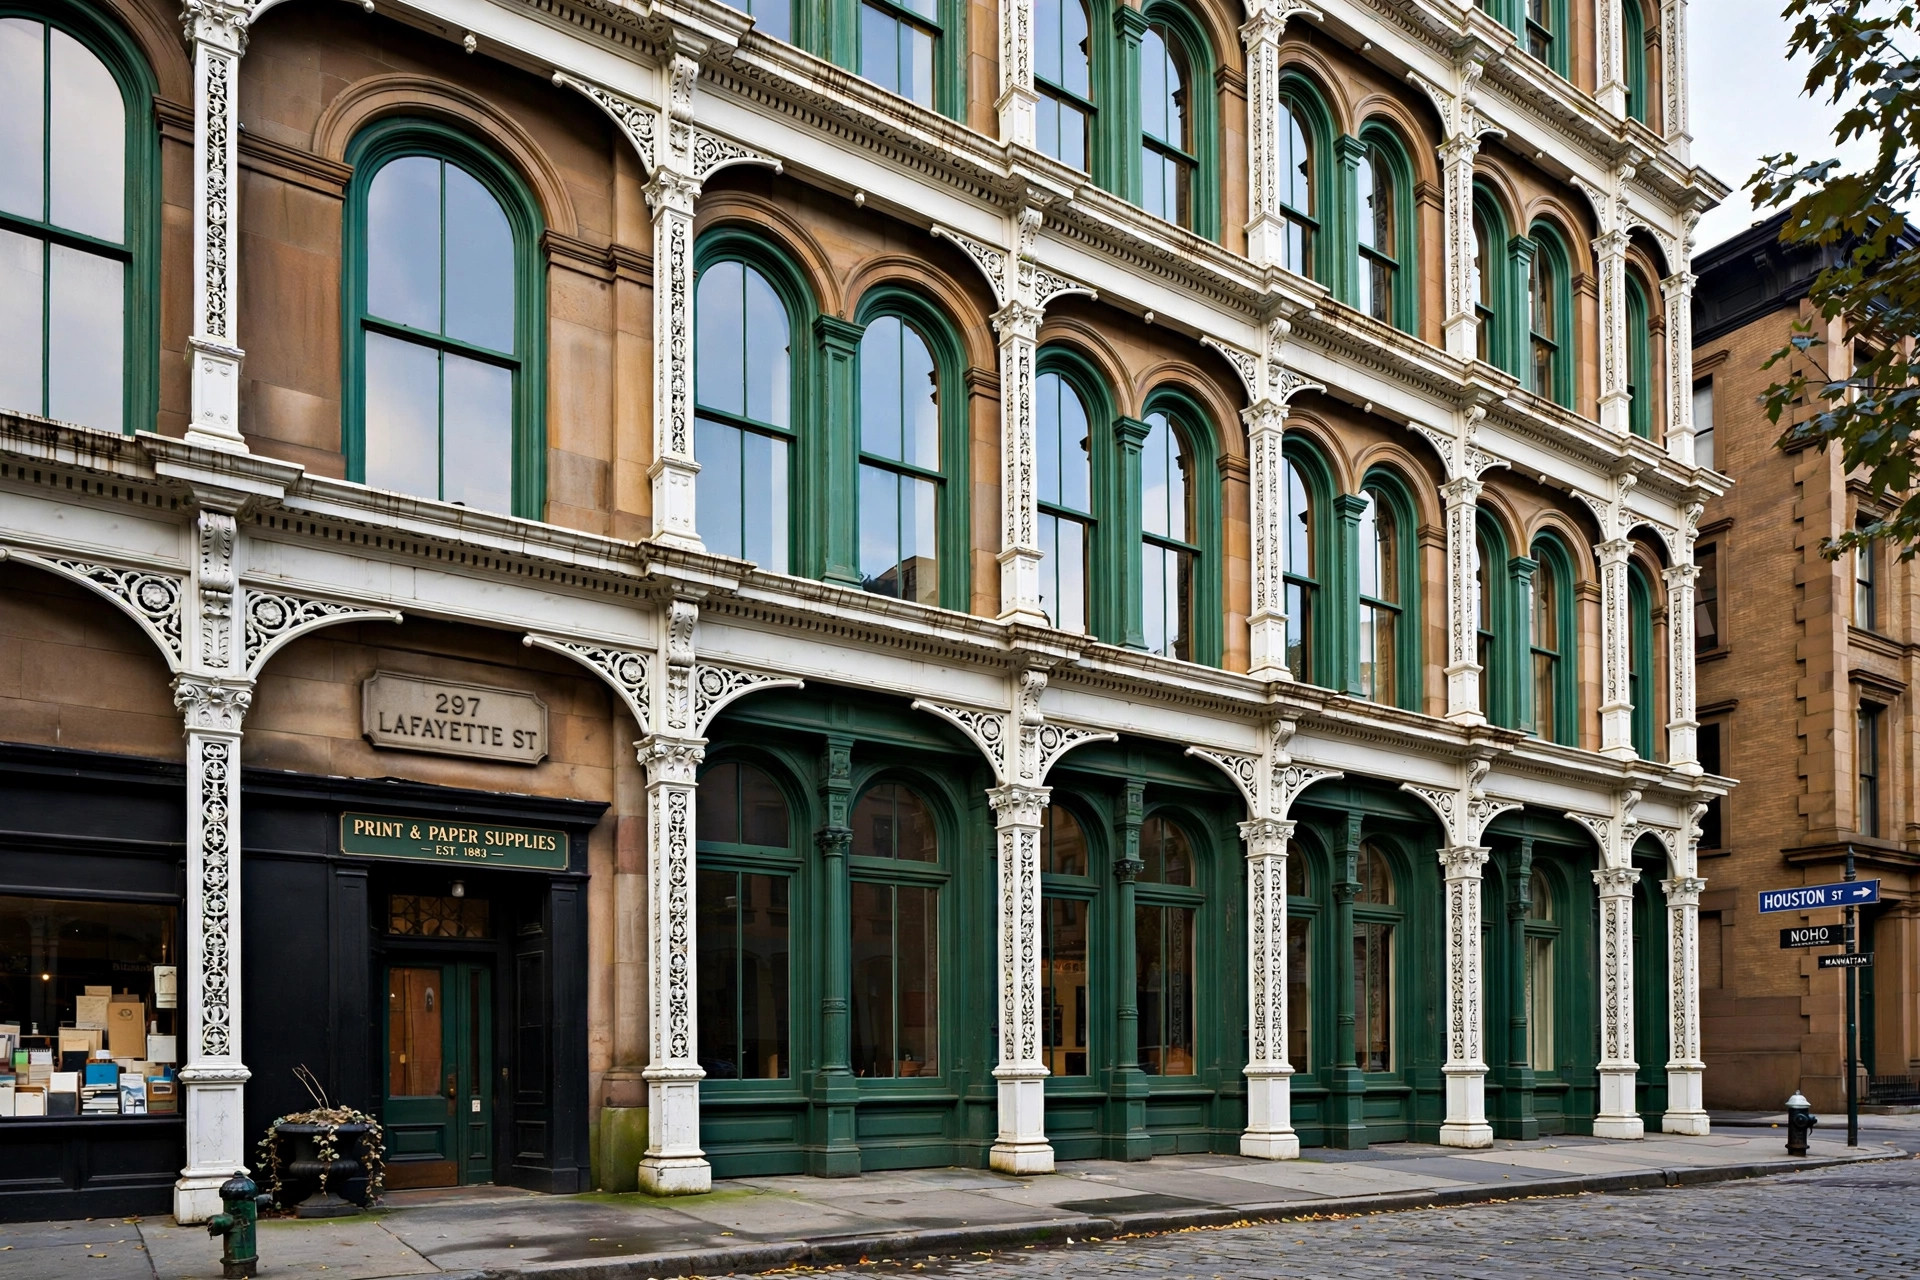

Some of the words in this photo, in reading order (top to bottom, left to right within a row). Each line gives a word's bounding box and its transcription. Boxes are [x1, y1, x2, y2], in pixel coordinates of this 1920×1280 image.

[436, 693, 480, 718] 297
[378, 712, 503, 746] LAFAYETTE
[512, 729, 537, 750] ST
[354, 819, 404, 838] PRINT
[410, 825, 422, 840] &
[428, 826, 478, 844] PAPER
[485, 830, 556, 851] SUPPLIES
[436, 846, 458, 856] EST.
[464, 847, 487, 858] 1883
[1764, 890, 1825, 909] HOUSTON
[1832, 890, 1844, 901] ST
[1790, 928, 1828, 942] NOHO
